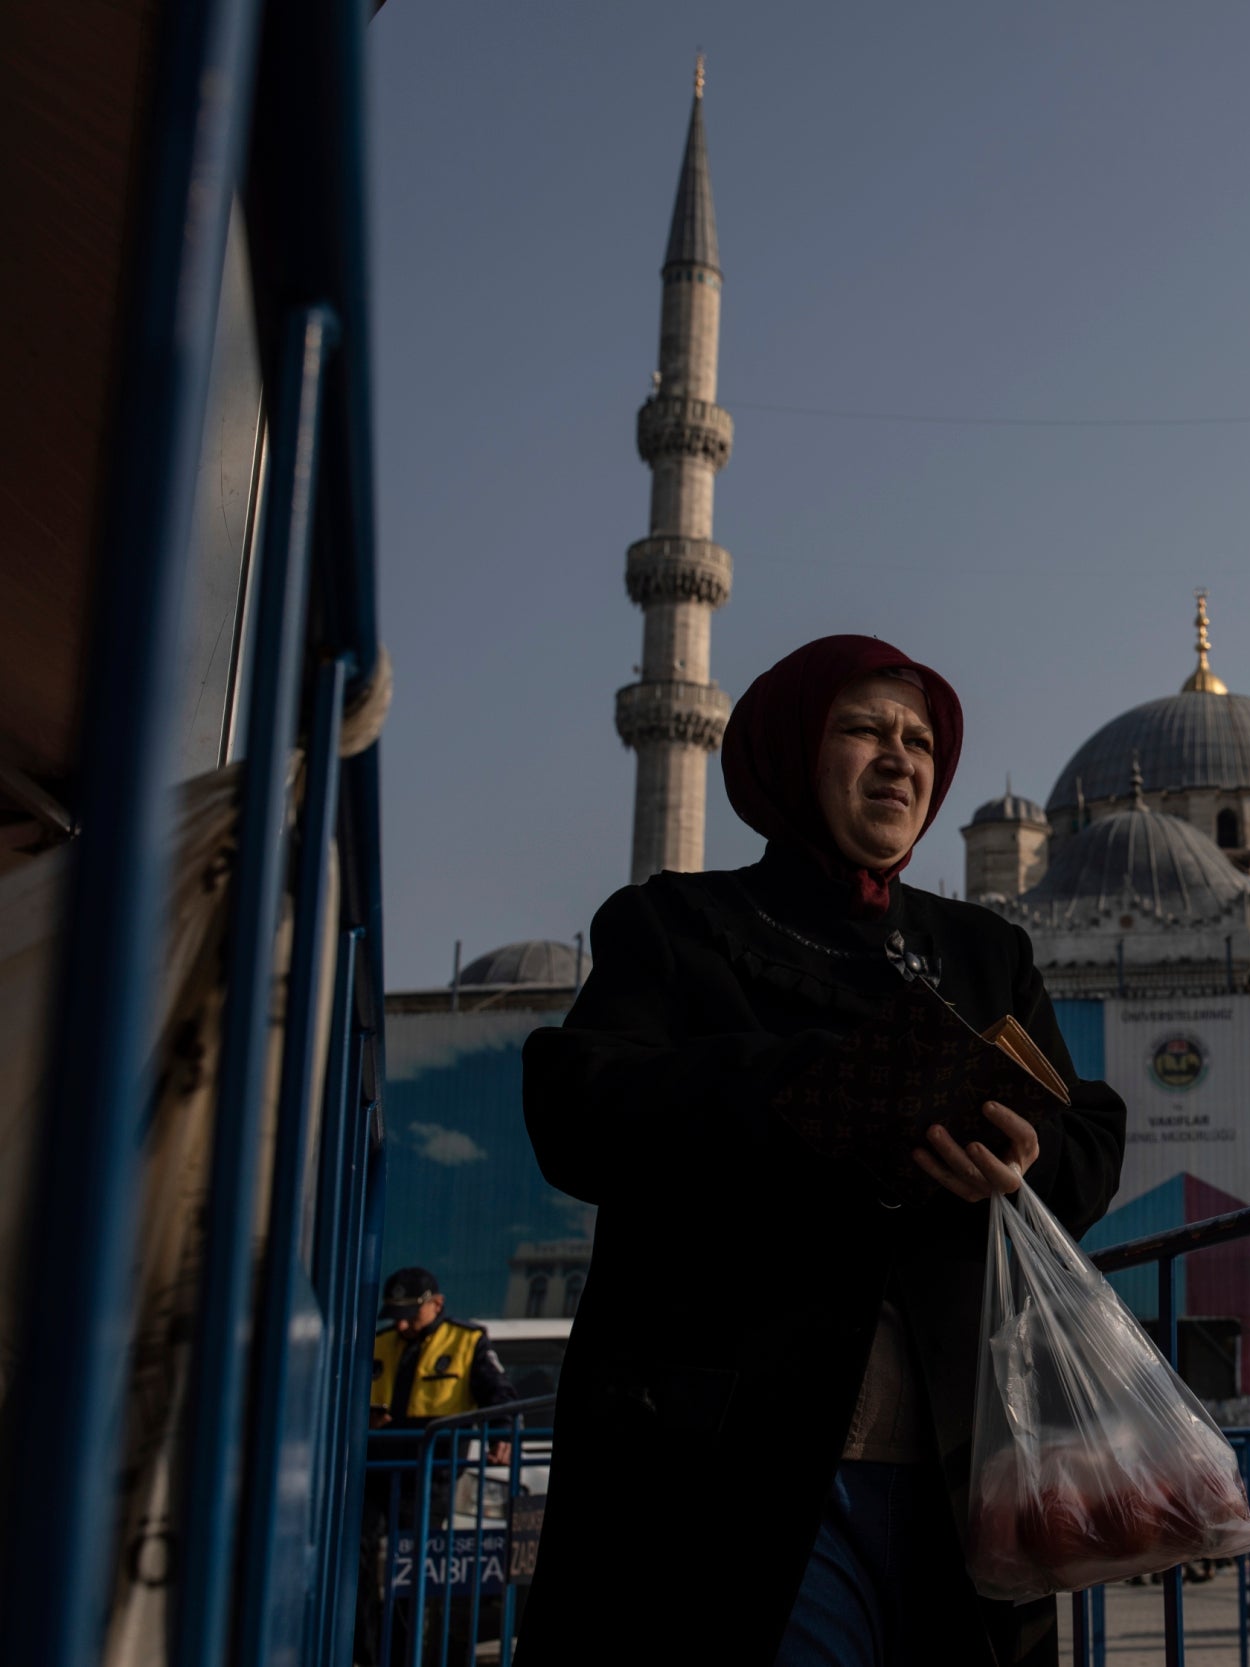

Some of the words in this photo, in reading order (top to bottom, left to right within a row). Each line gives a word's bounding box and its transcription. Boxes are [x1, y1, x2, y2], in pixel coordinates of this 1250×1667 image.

[398, 1535, 505, 1554] BÜŞEHİR
[510, 1541, 537, 1576] ZAB
[392, 1556, 504, 1586] ZABITA
